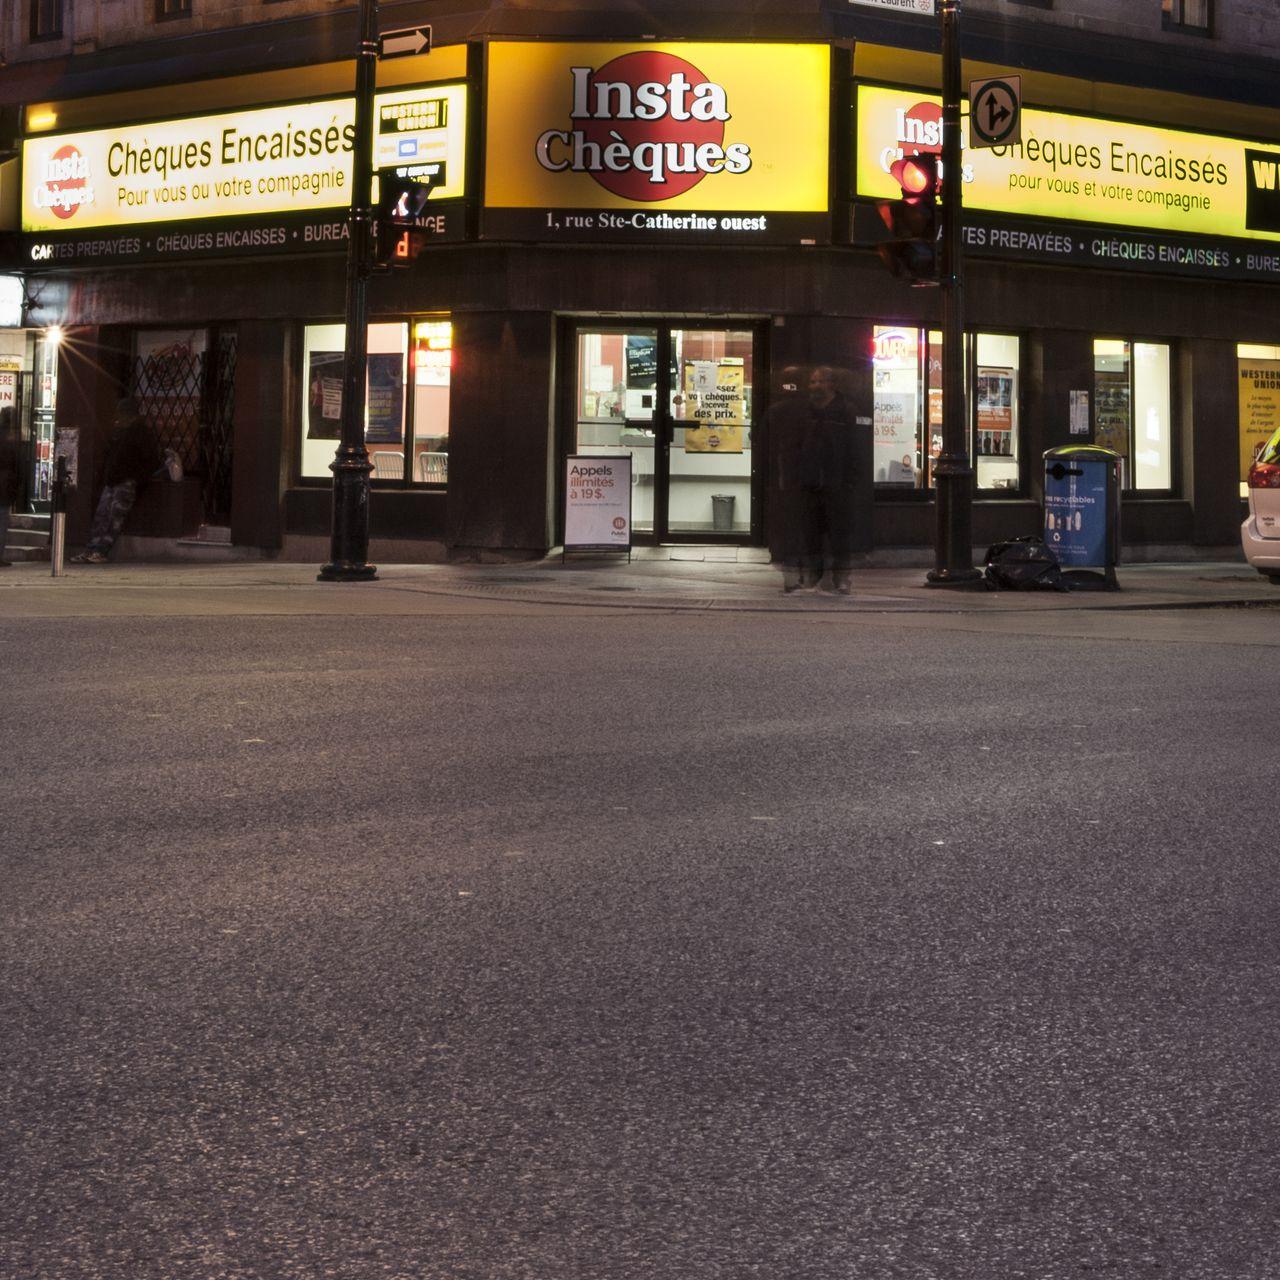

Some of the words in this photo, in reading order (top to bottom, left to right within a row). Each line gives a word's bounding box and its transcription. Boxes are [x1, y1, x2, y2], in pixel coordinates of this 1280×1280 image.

[571, 67, 732, 122] Insta
[107, 137, 212, 180] Chèques
[221, 116, 356, 165] Encaissés
[535, 129, 752, 183] Chèques
[1111, 141, 1228, 186] Encaissés
[118, 187, 149, 208] Pour
[151, 184, 187, 204] vous
[192, 183, 210, 201] ou
[215, 179, 253, 199] votre
[257, 169, 345, 201] compagnie
[1008, 173, 1042, 191] pour
[1046, 176, 1080, 195] vous
[1084, 179, 1097, 197] et
[1101, 182, 1134, 203] votre
[1137, 185, 1211, 212] compagnie
[565, 215, 594, 228] rue
[598, 212, 718, 230] Ste-Catherine
[720, 215, 767, 230] ouest
[31, 242, 74, 261] CARTES
[156, 231, 213, 252] CHÈQUES
[303, 225, 350, 242] BUREA
[990, 228, 1072, 253] PREPAYÉES
[1092, 239, 1156, 261] CHÈQUES
[1158, 244, 1230, 268] ENCAISSÉS
[694, 409, 711, 418] des
[715, 410, 737, 419] prix.
[705, 393, 742, 404] chèques.
[570, 465, 613, 477] Appels
[570, 477, 614, 487] illimités
[570, 488, 577, 499] à
